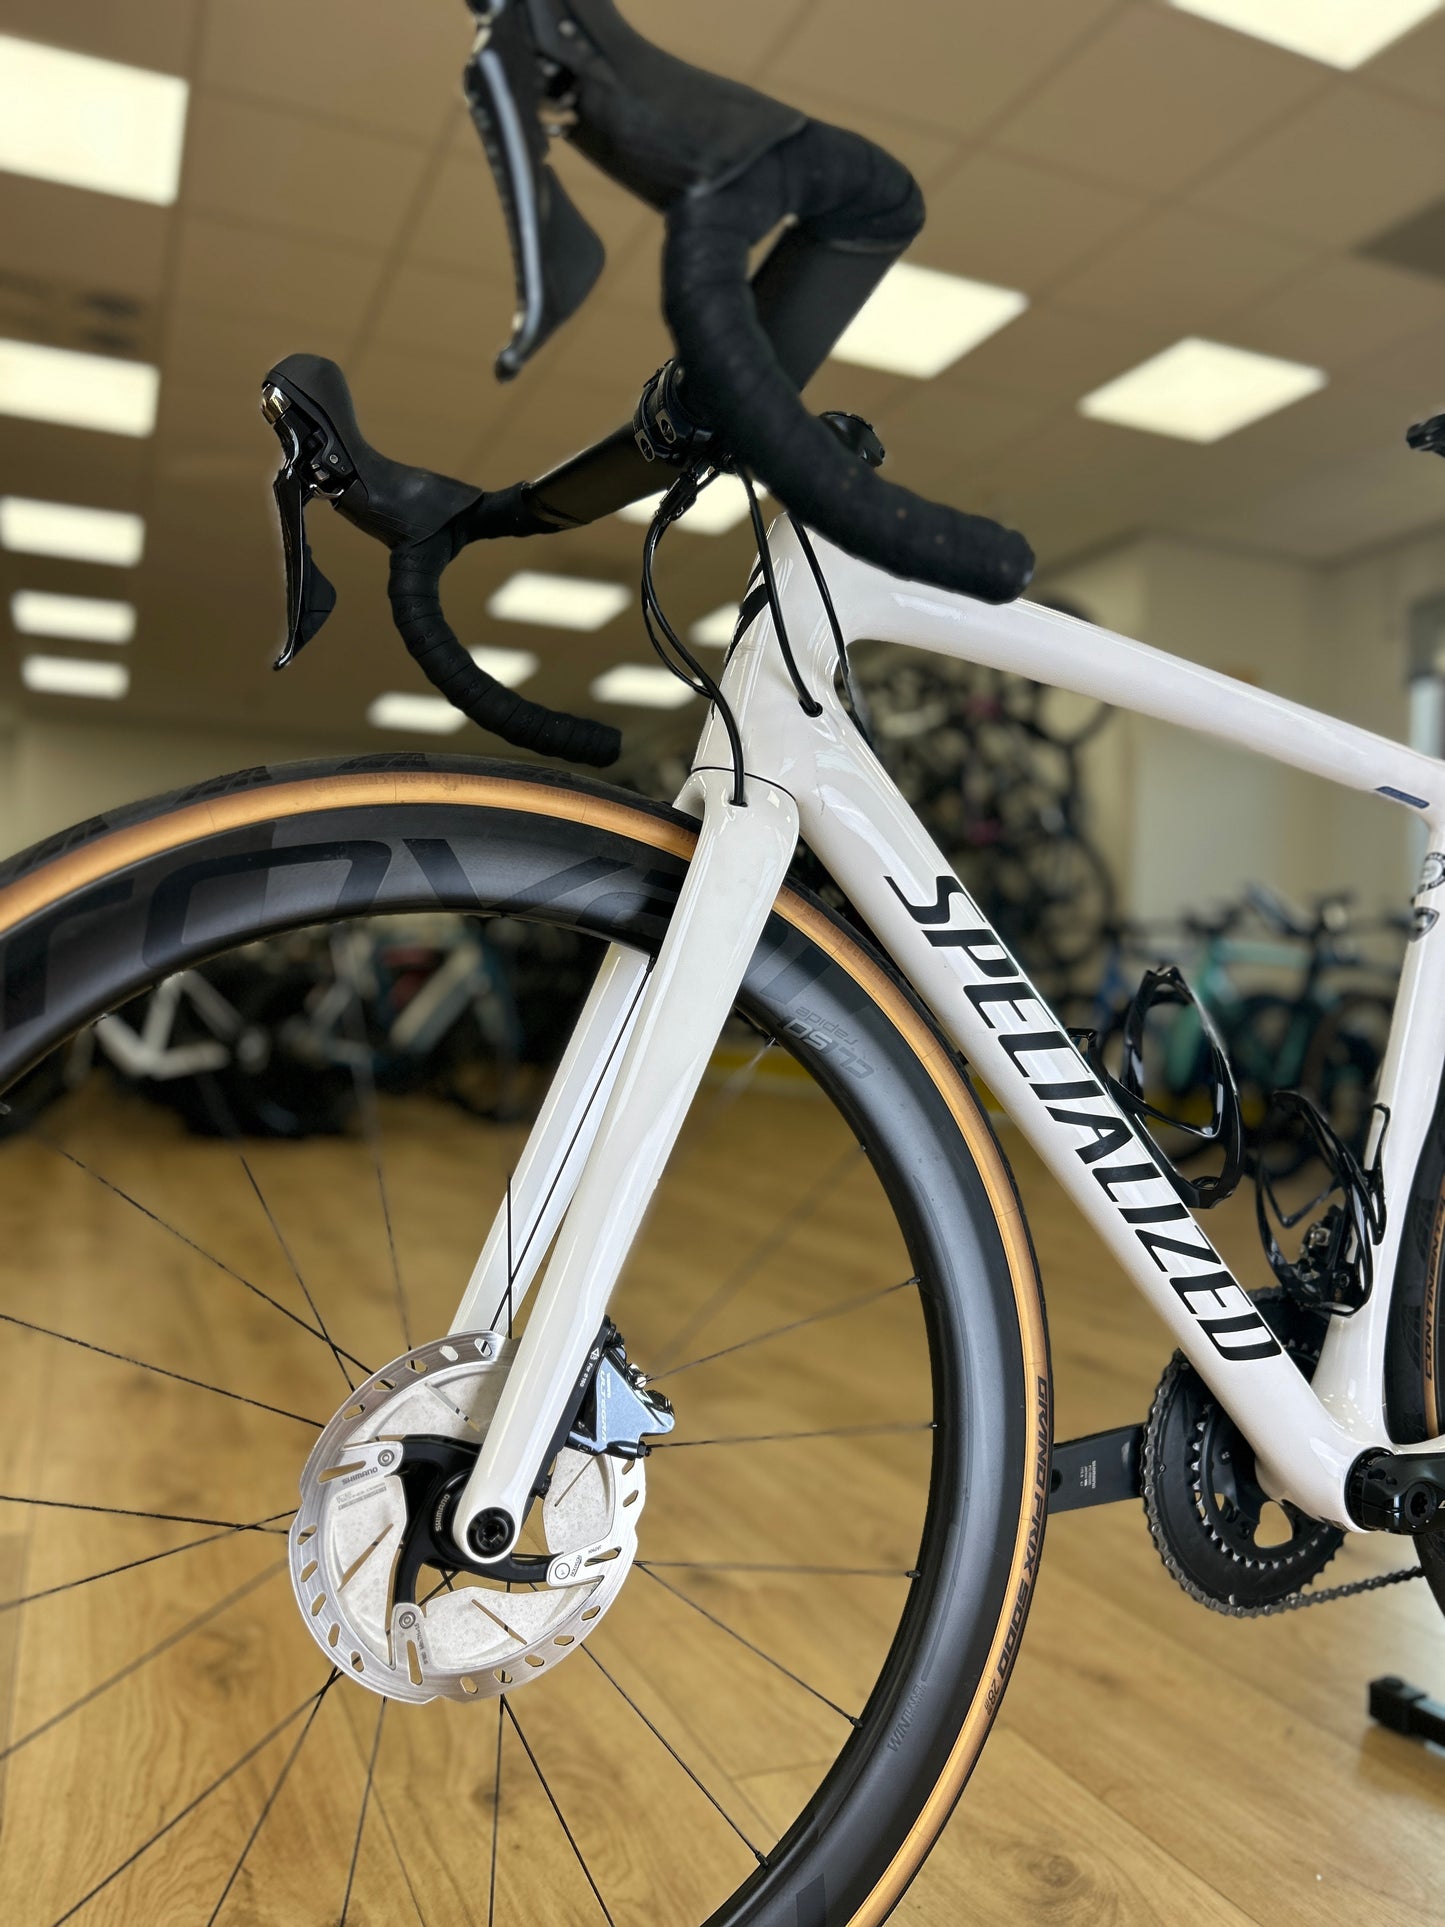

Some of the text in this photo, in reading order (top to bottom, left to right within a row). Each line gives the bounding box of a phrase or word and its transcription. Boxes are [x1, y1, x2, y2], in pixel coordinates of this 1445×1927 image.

[795, 1006, 859, 1046] rapide
[883, 875, 1282, 1361] SPECIALIZED
[342, 1467, 378, 1485] SHIMANO
[1035, 1375, 1048, 1491] GRAND
[435, 1494, 450, 1532] SHIMANO
[1024, 1491, 1044, 1578] PRIX
[997, 1578, 1029, 1679] 5000
